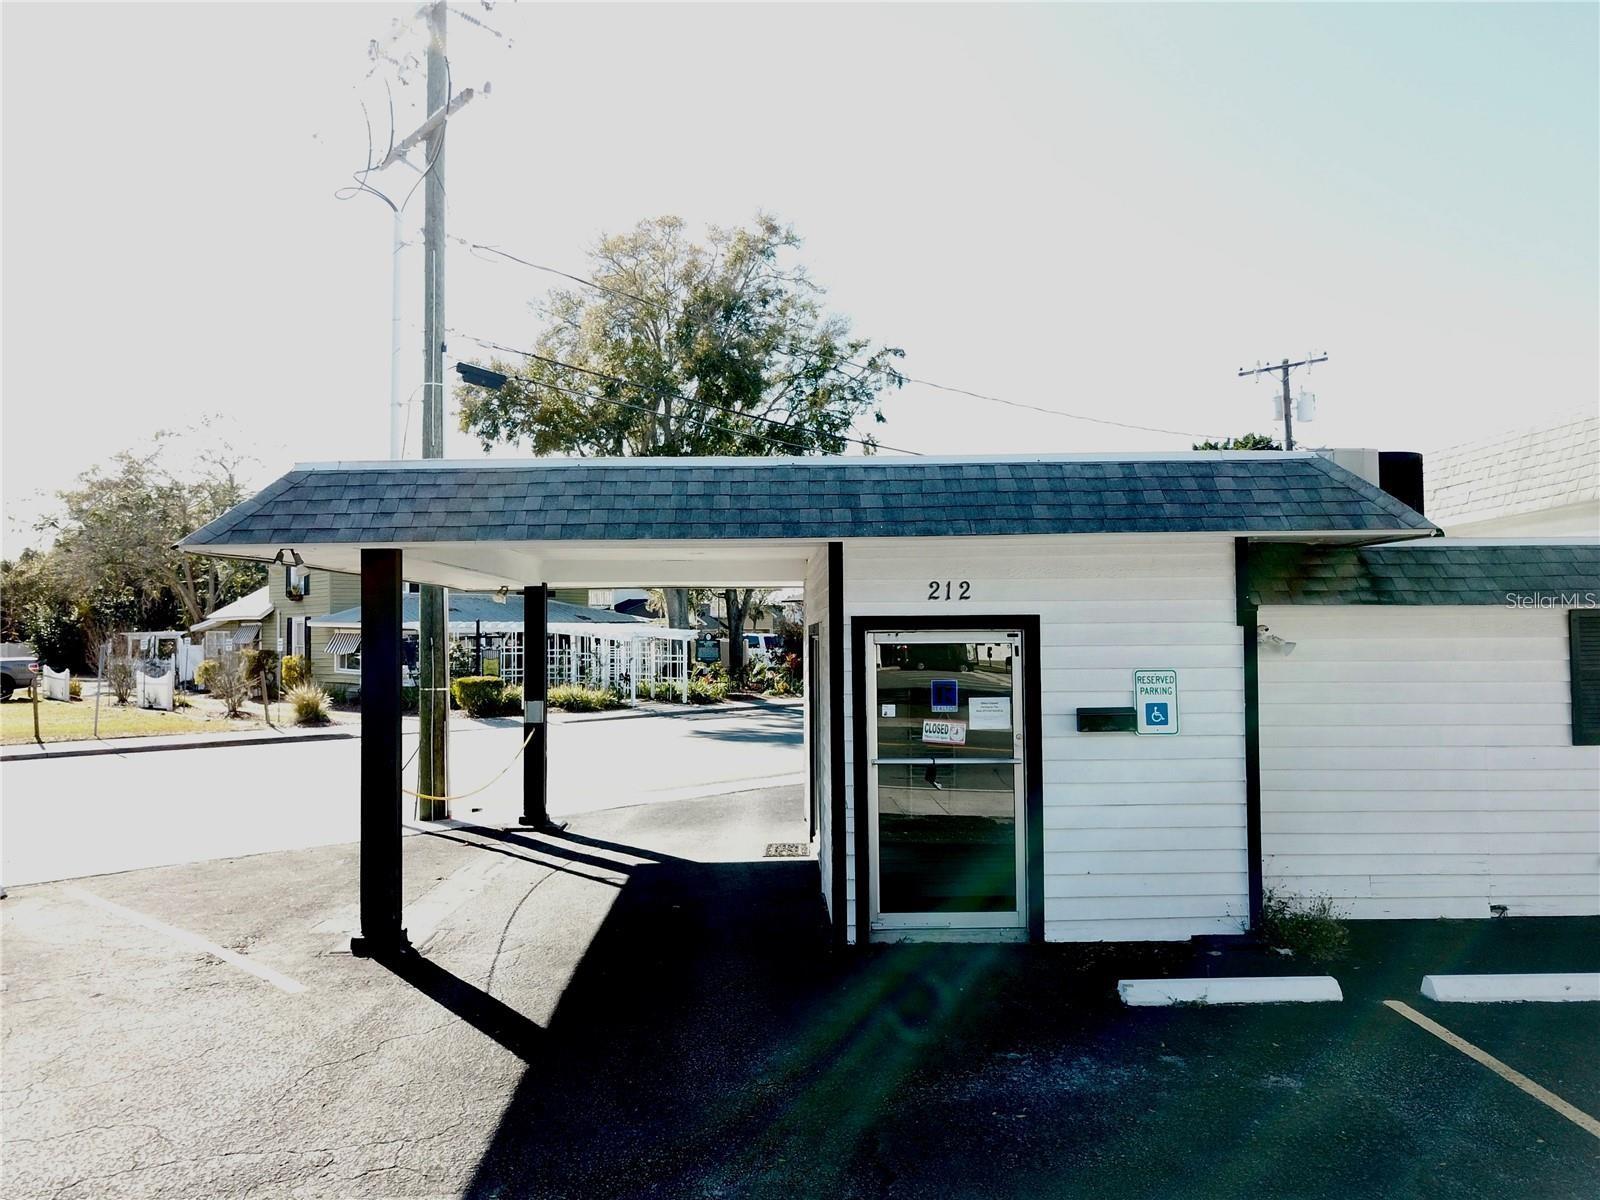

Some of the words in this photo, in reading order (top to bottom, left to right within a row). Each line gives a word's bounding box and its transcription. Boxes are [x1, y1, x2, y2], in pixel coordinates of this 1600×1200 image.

[927, 580, 972, 601] 212
[1136, 675, 1175, 685] RESERVED
[1140, 686, 1173, 696] PARKING
[925, 722, 949, 735] CLOSED
